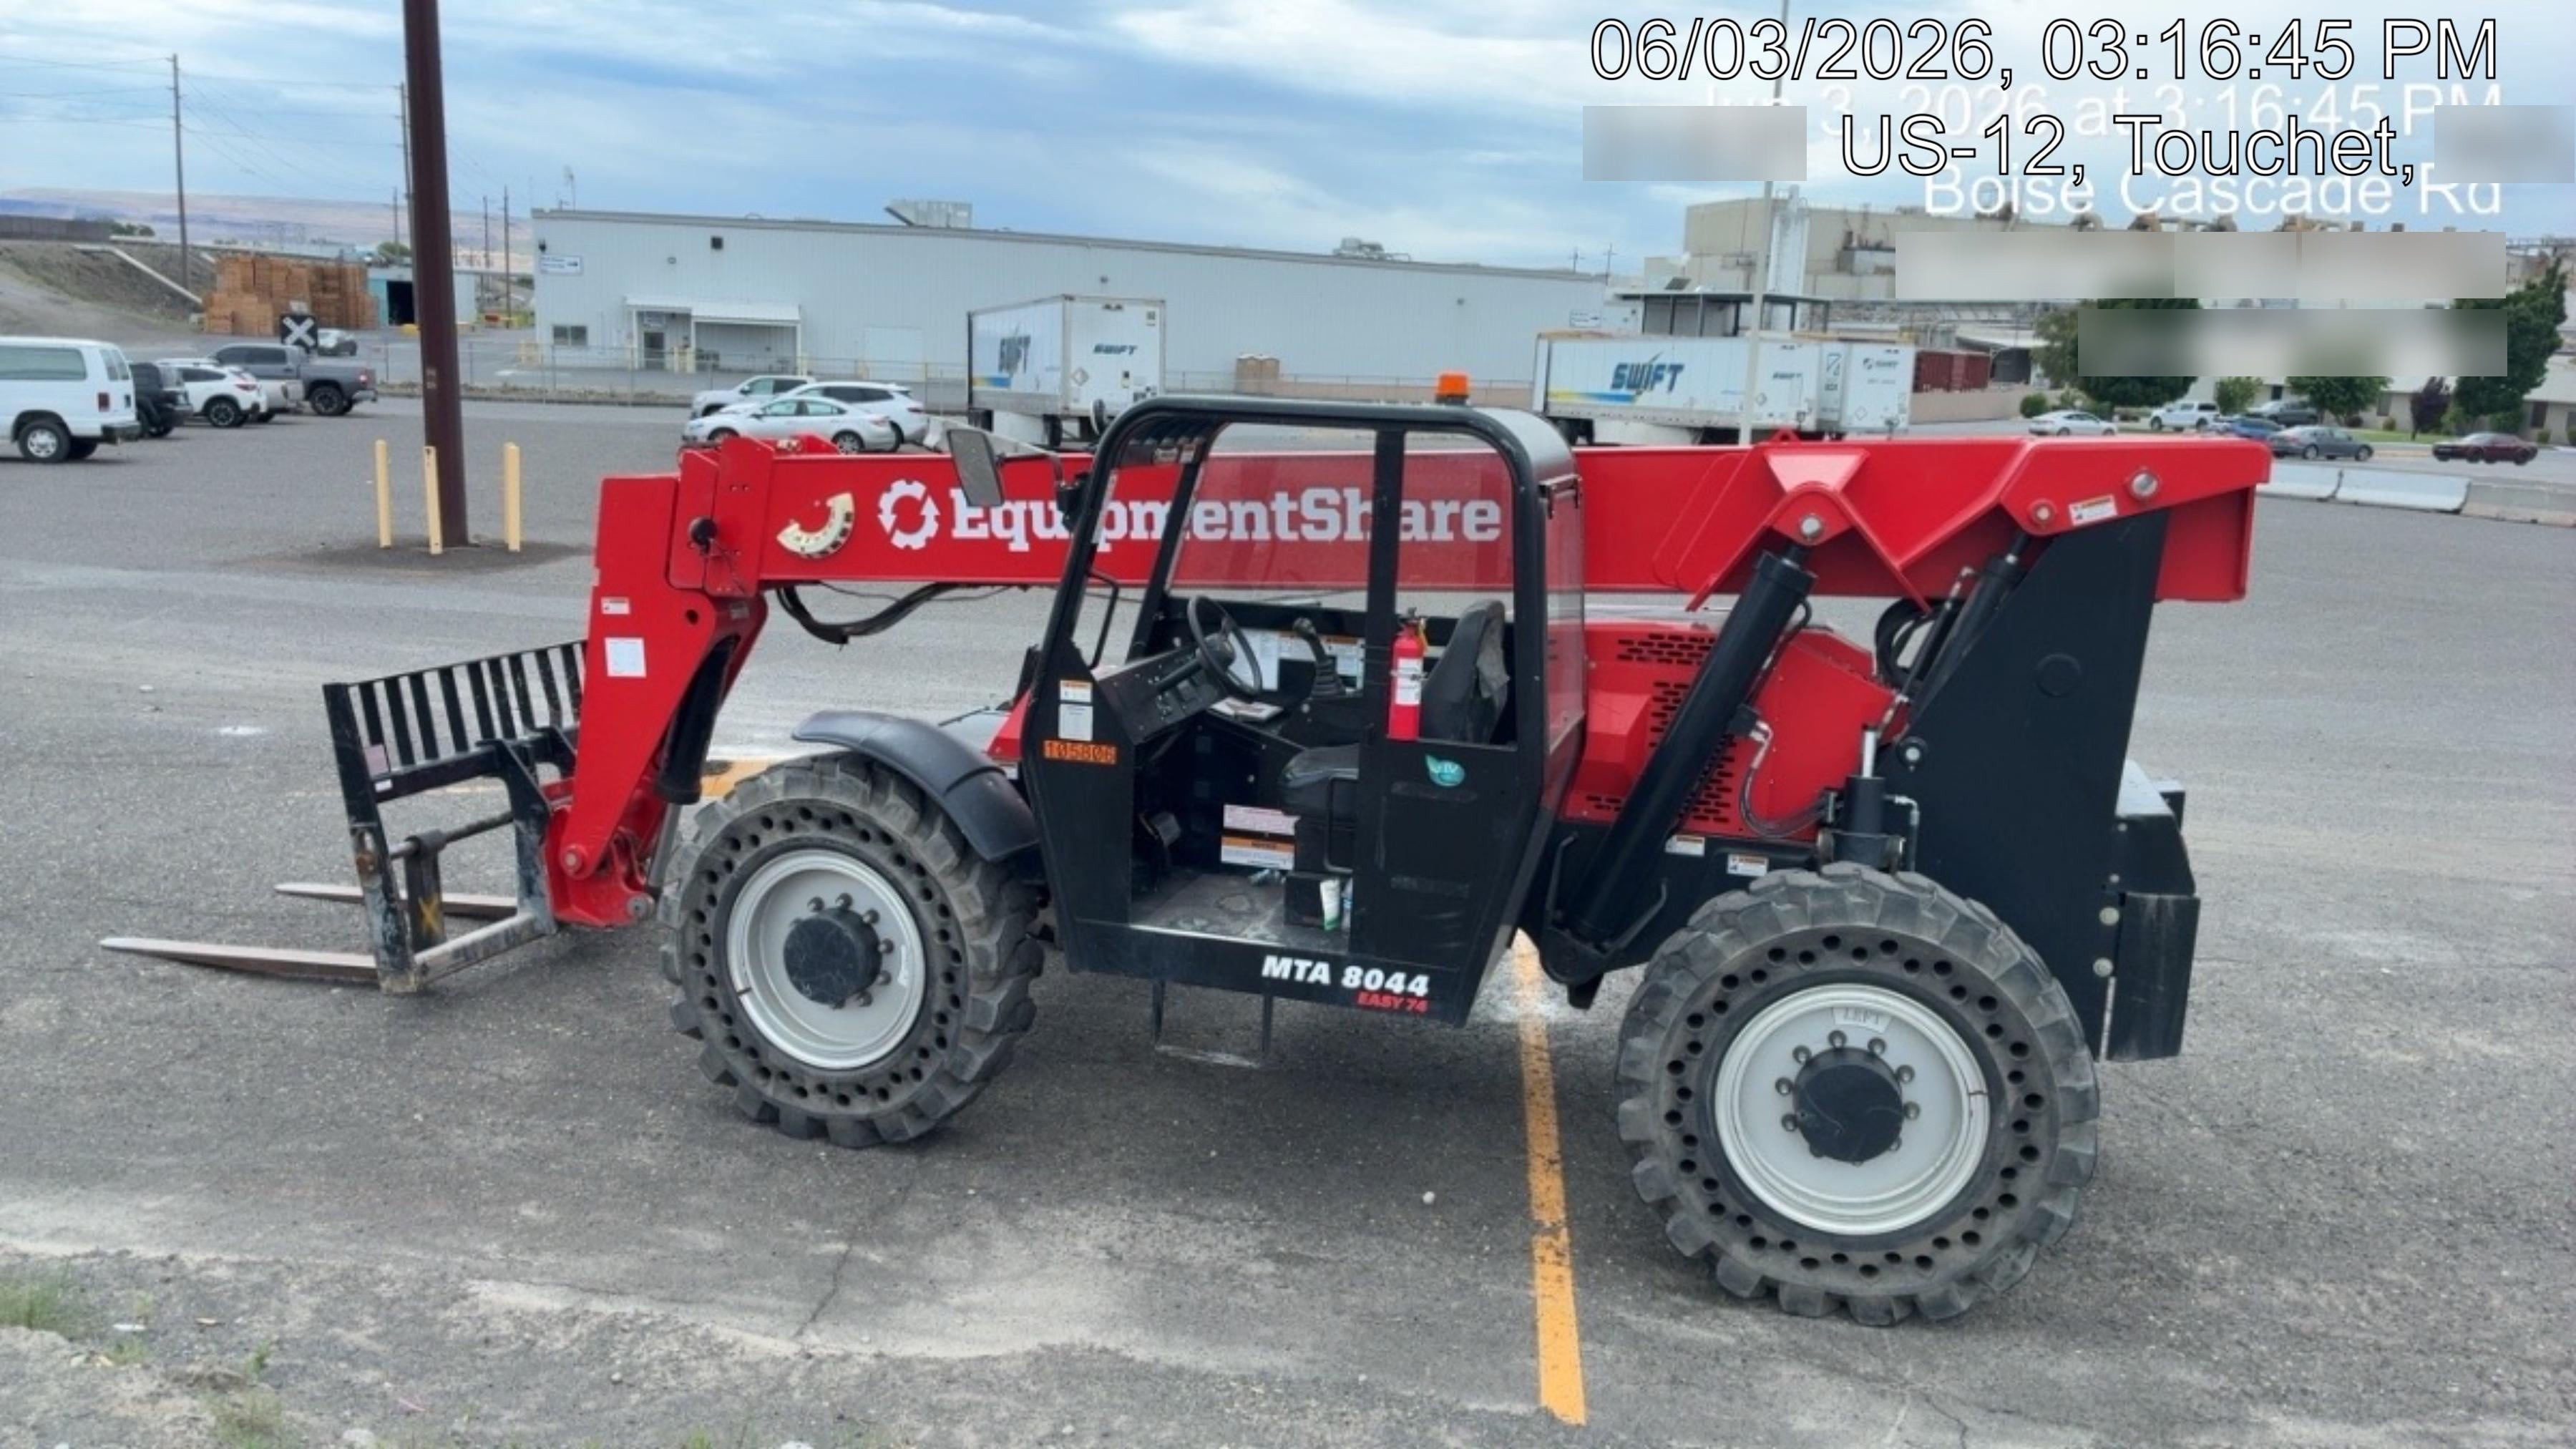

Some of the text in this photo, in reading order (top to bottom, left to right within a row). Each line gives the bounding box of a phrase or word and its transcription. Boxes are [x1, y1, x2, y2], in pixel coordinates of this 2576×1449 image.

[1611, 356, 1684, 394] SWIFT
[1262, 954, 1429, 997] MTA 8044
[1357, 992, 1405, 1009] EASY
